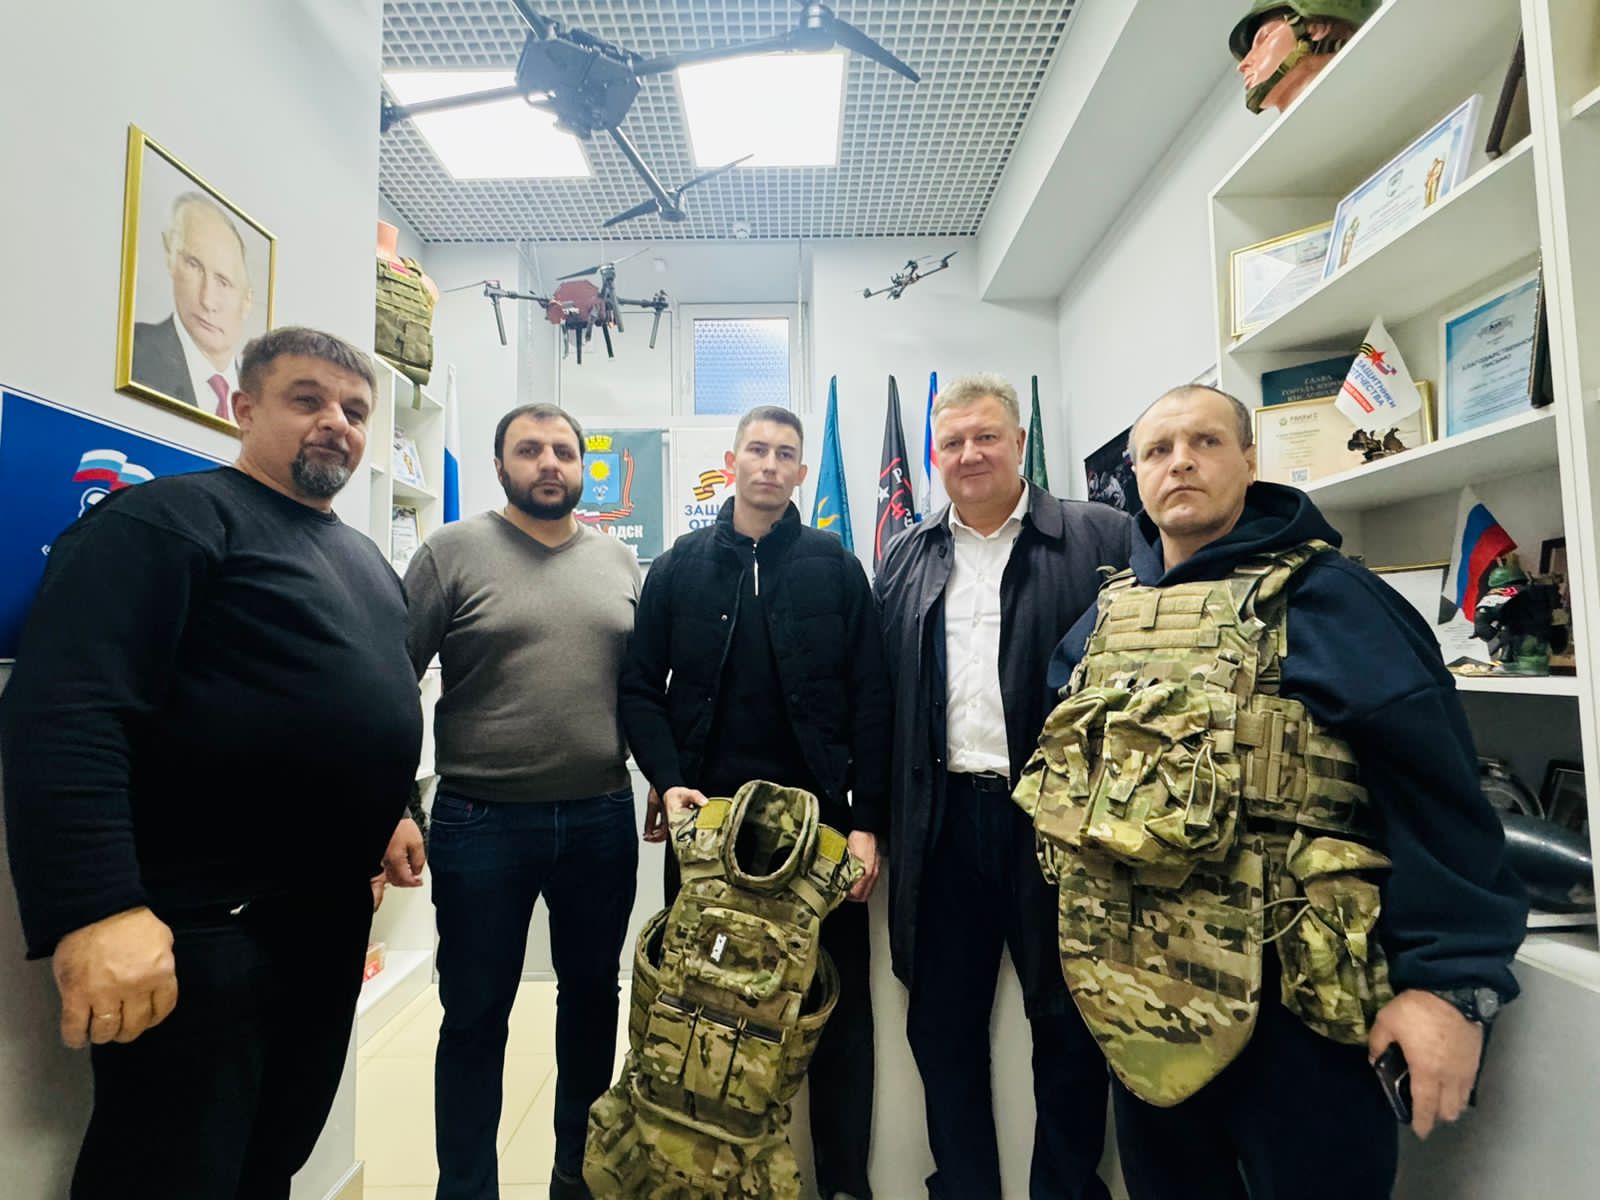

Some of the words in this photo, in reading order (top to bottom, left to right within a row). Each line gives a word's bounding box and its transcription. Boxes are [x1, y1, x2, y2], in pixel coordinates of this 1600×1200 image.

[1355, 359, 1397, 409] ЗАЩИТНИКИ
[684, 504, 721, 516] ЗАЩ
[607, 524, 644, 540] ОДСК
